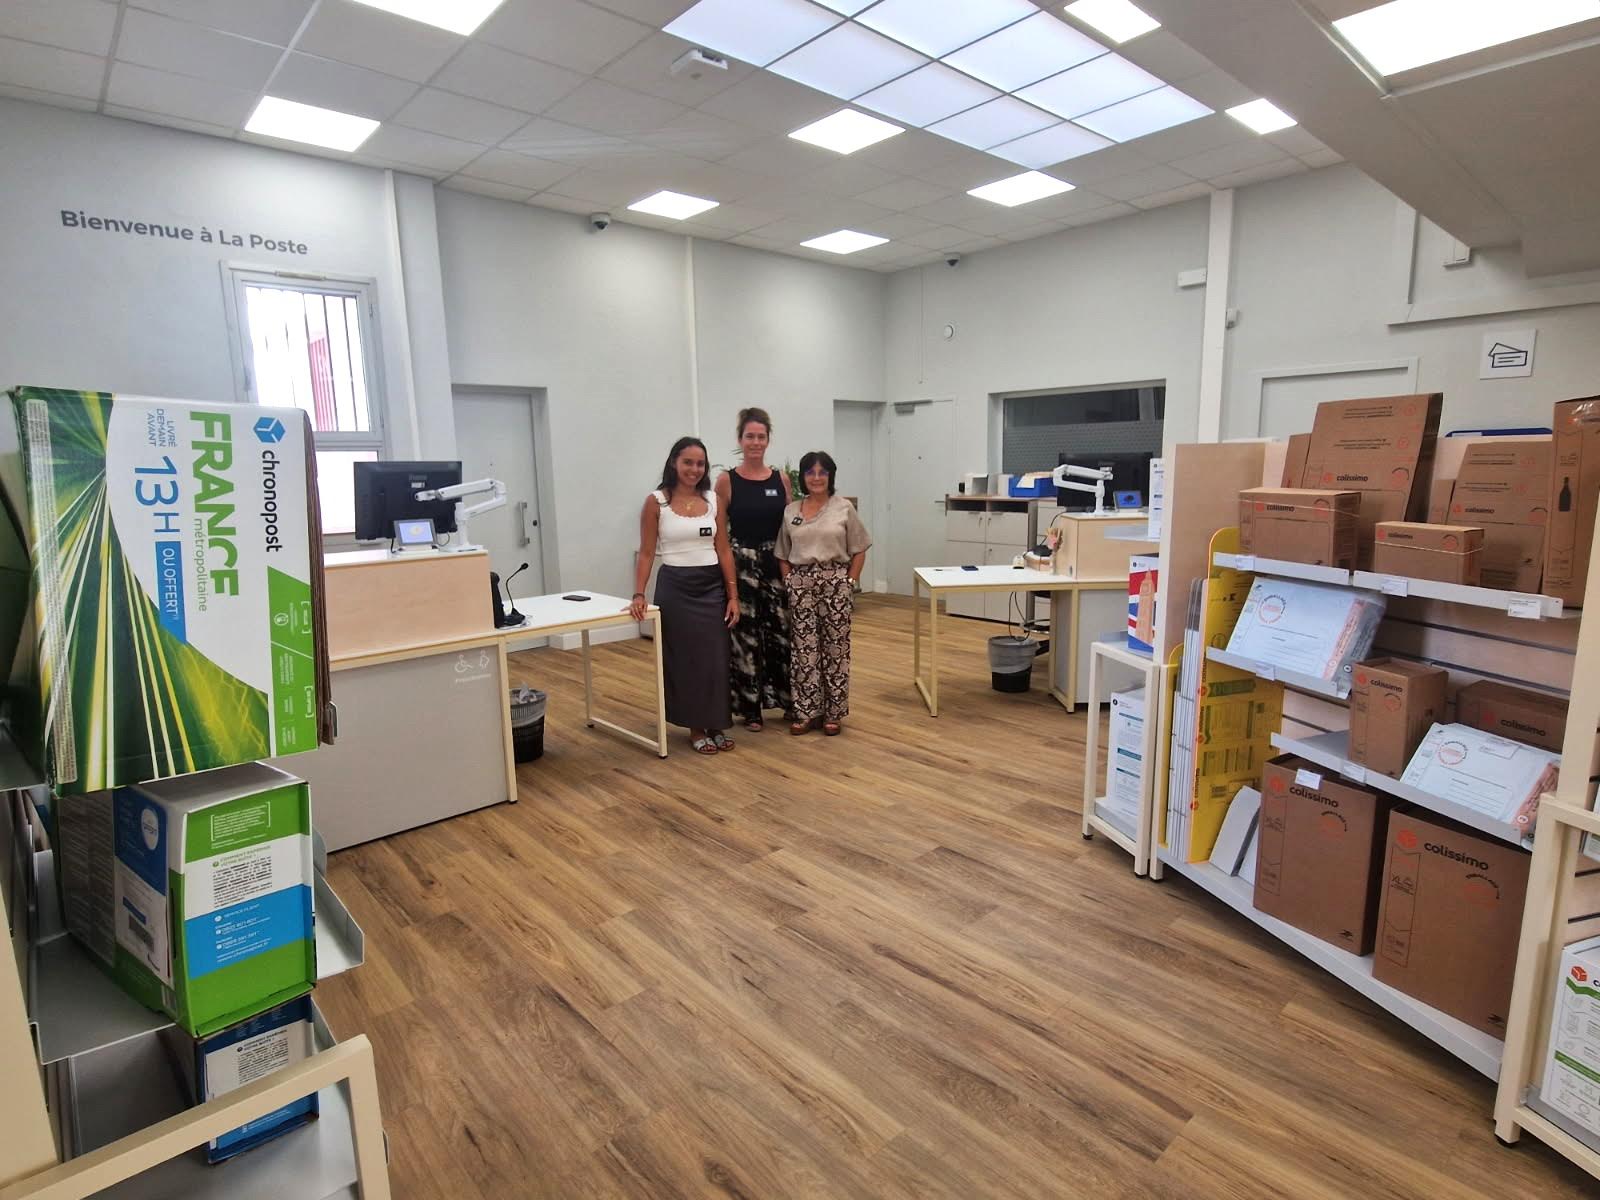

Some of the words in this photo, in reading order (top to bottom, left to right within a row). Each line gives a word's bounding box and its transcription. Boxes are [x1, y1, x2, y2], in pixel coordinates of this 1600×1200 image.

[61, 210, 194, 241] Bienvenue
[200, 226, 213, 244] à
[219, 229, 244, 248] La
[250, 234, 308, 255] Poste
[147, 412, 157, 447] AVANT
[156, 408, 167, 448] DEMAIN
[166, 419, 177, 447] LIVRÉ
[134, 455, 180, 507] 13
[1336, 473, 1368, 482] colissimo
[190, 410, 239, 596] FRANCE
[260, 450, 283, 553] chronopost
[1266, 504, 1295, 513] colissimo
[153, 512, 181, 533] H
[162, 547, 176, 566] OU
[193, 517, 207, 612] métropolitaine
[1370, 679, 1403, 693] colissimo
[1500, 719, 1546, 737] colissimo
[1289, 786, 1339, 808] colissimo
[1424, 842, 1489, 871] colissimo
